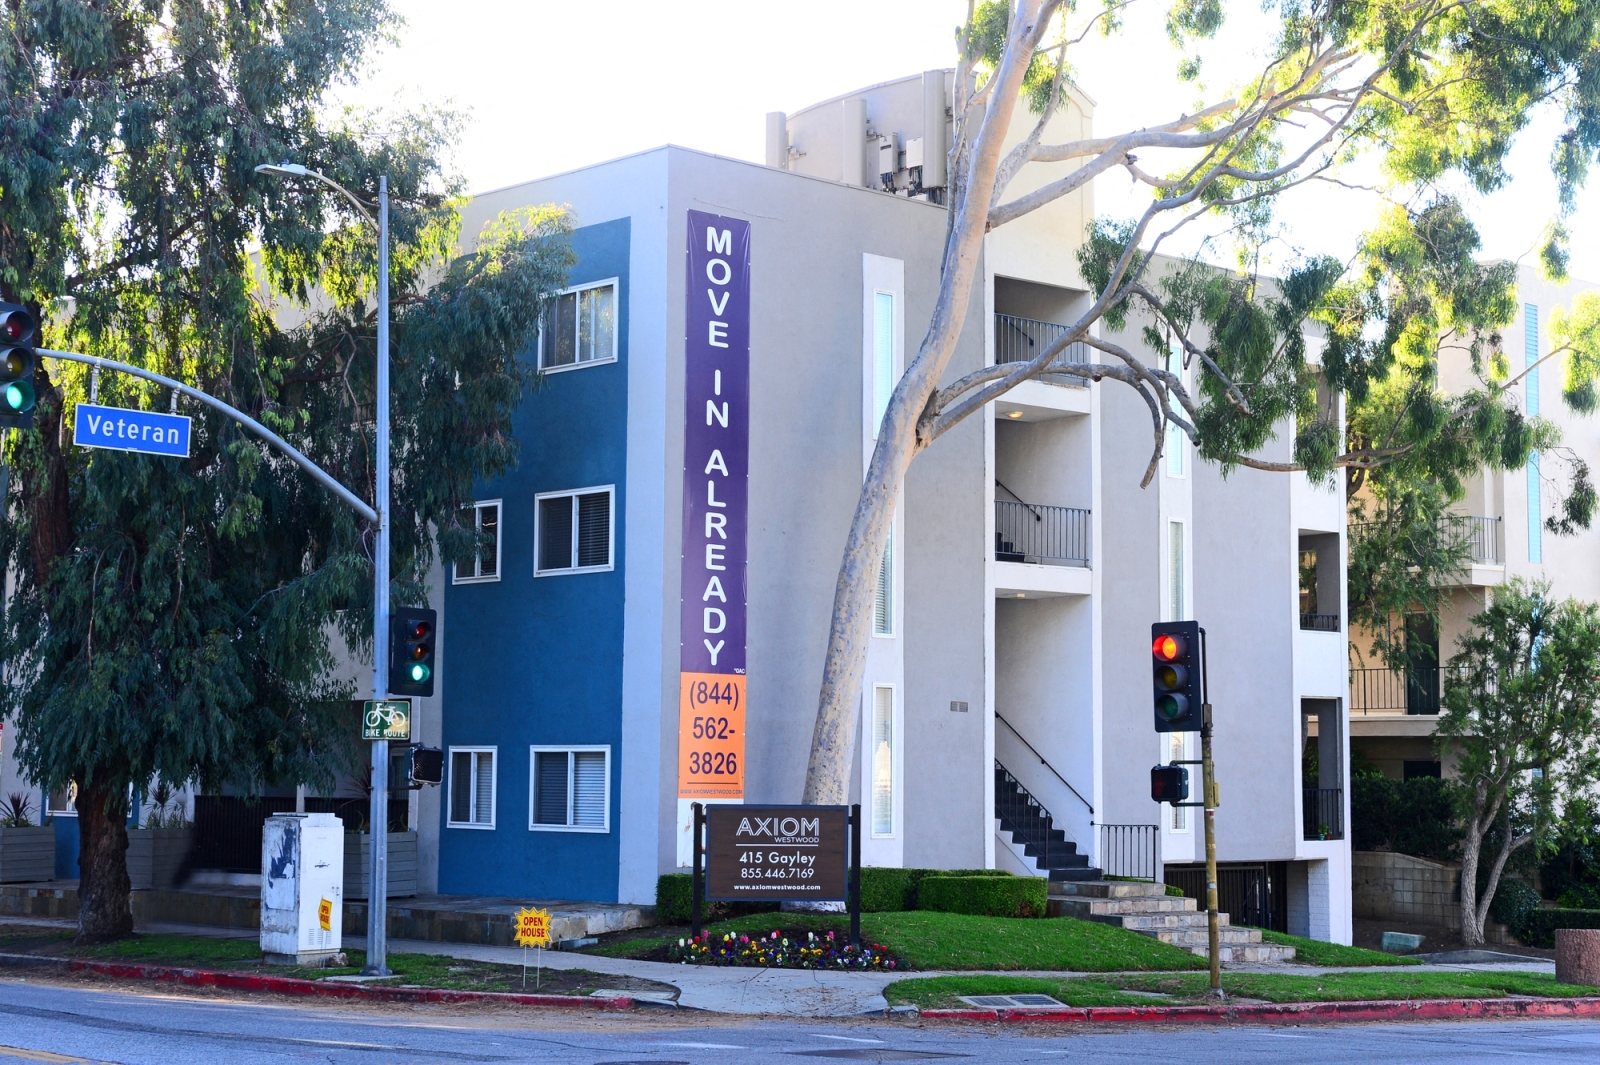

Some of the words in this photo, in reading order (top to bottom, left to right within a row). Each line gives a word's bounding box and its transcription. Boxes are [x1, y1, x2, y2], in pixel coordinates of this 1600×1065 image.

[706, 226, 732, 349] MOVE
[706, 369, 729, 428] IN
[87, 414, 179, 445] Veteran
[702, 449, 728, 666] ALREADY
[689, 681, 739, 711] (844)
[365, 729, 380, 737] BIKE
[384, 729, 406, 737] ROUTE
[692, 716, 736, 740] 562-
[689, 751, 737, 775] 3826
[735, 817, 820, 837] AXIOM
[739, 851, 763, 864] 415
[768, 850, 816, 867] Gayley
[741, 867, 815, 879] 855.446.7169
[521, 927, 546, 938] HOUSE
[523, 916, 544, 927] OPEN
